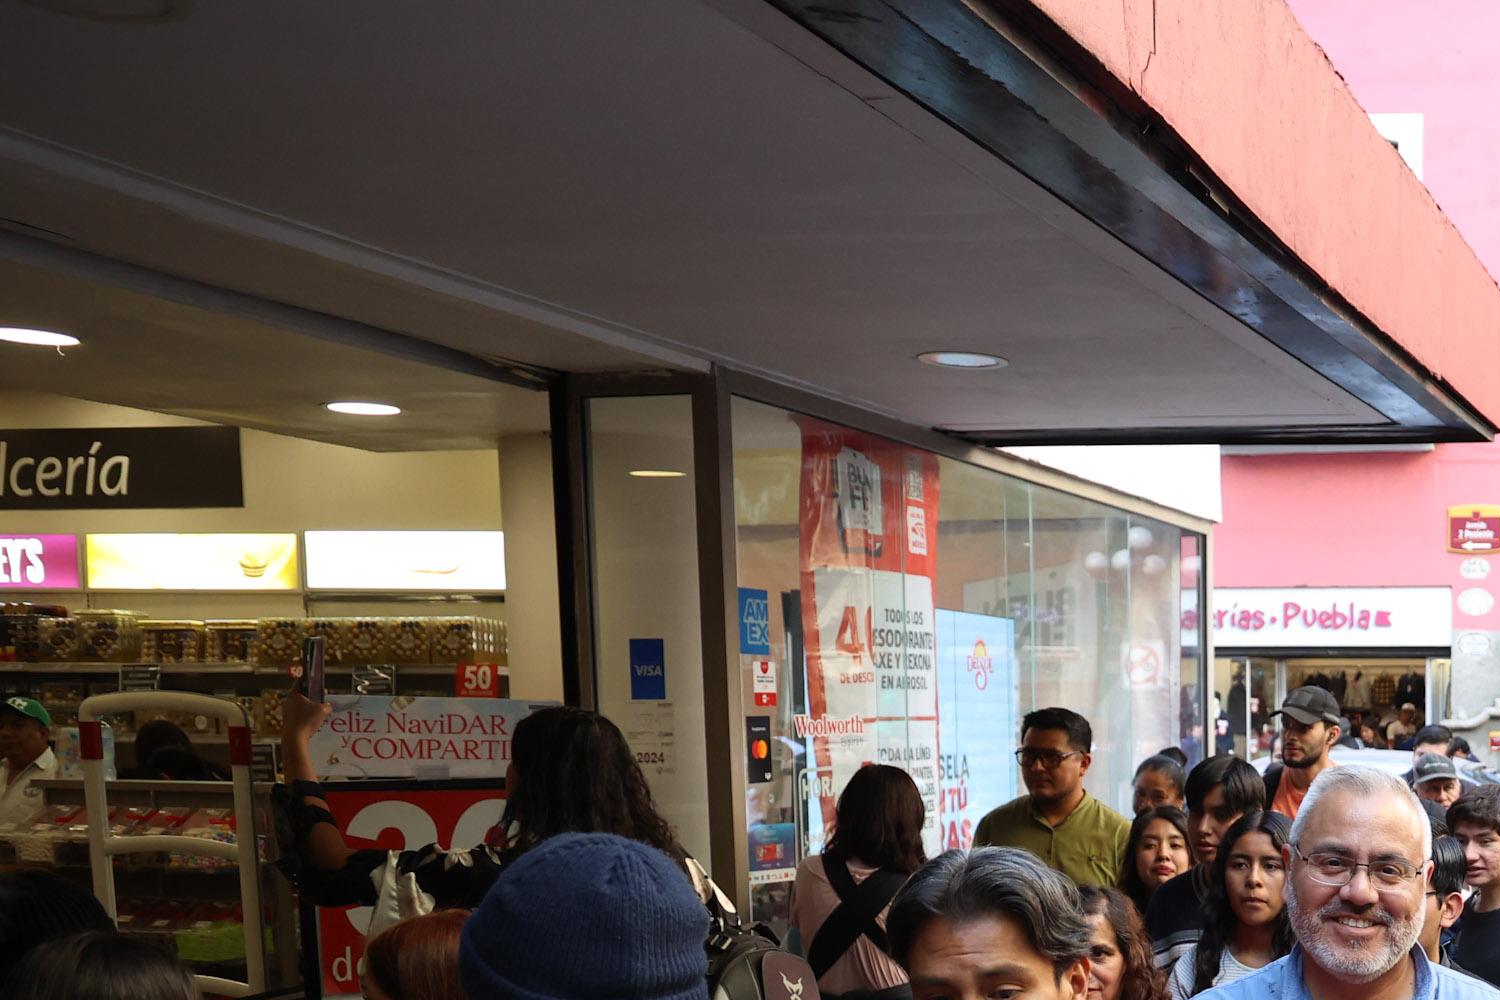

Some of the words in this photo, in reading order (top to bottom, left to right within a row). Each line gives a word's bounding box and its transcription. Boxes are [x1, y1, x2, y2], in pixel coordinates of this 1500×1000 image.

[1283, 602, 1372, 631] Puebla
[464, 665, 491, 690] 50
[635, 664, 662, 676] VISA
[881, 675, 894, 690] EN
[319, 711, 376, 733] eliz
[386, 712, 508, 735] NaviDAR
[794, 713, 864, 737] Woolworth
[341, 735, 351, 748] y
[351, 738, 511, 760] COMPARTI
[637, 752, 665, 763] 2024
